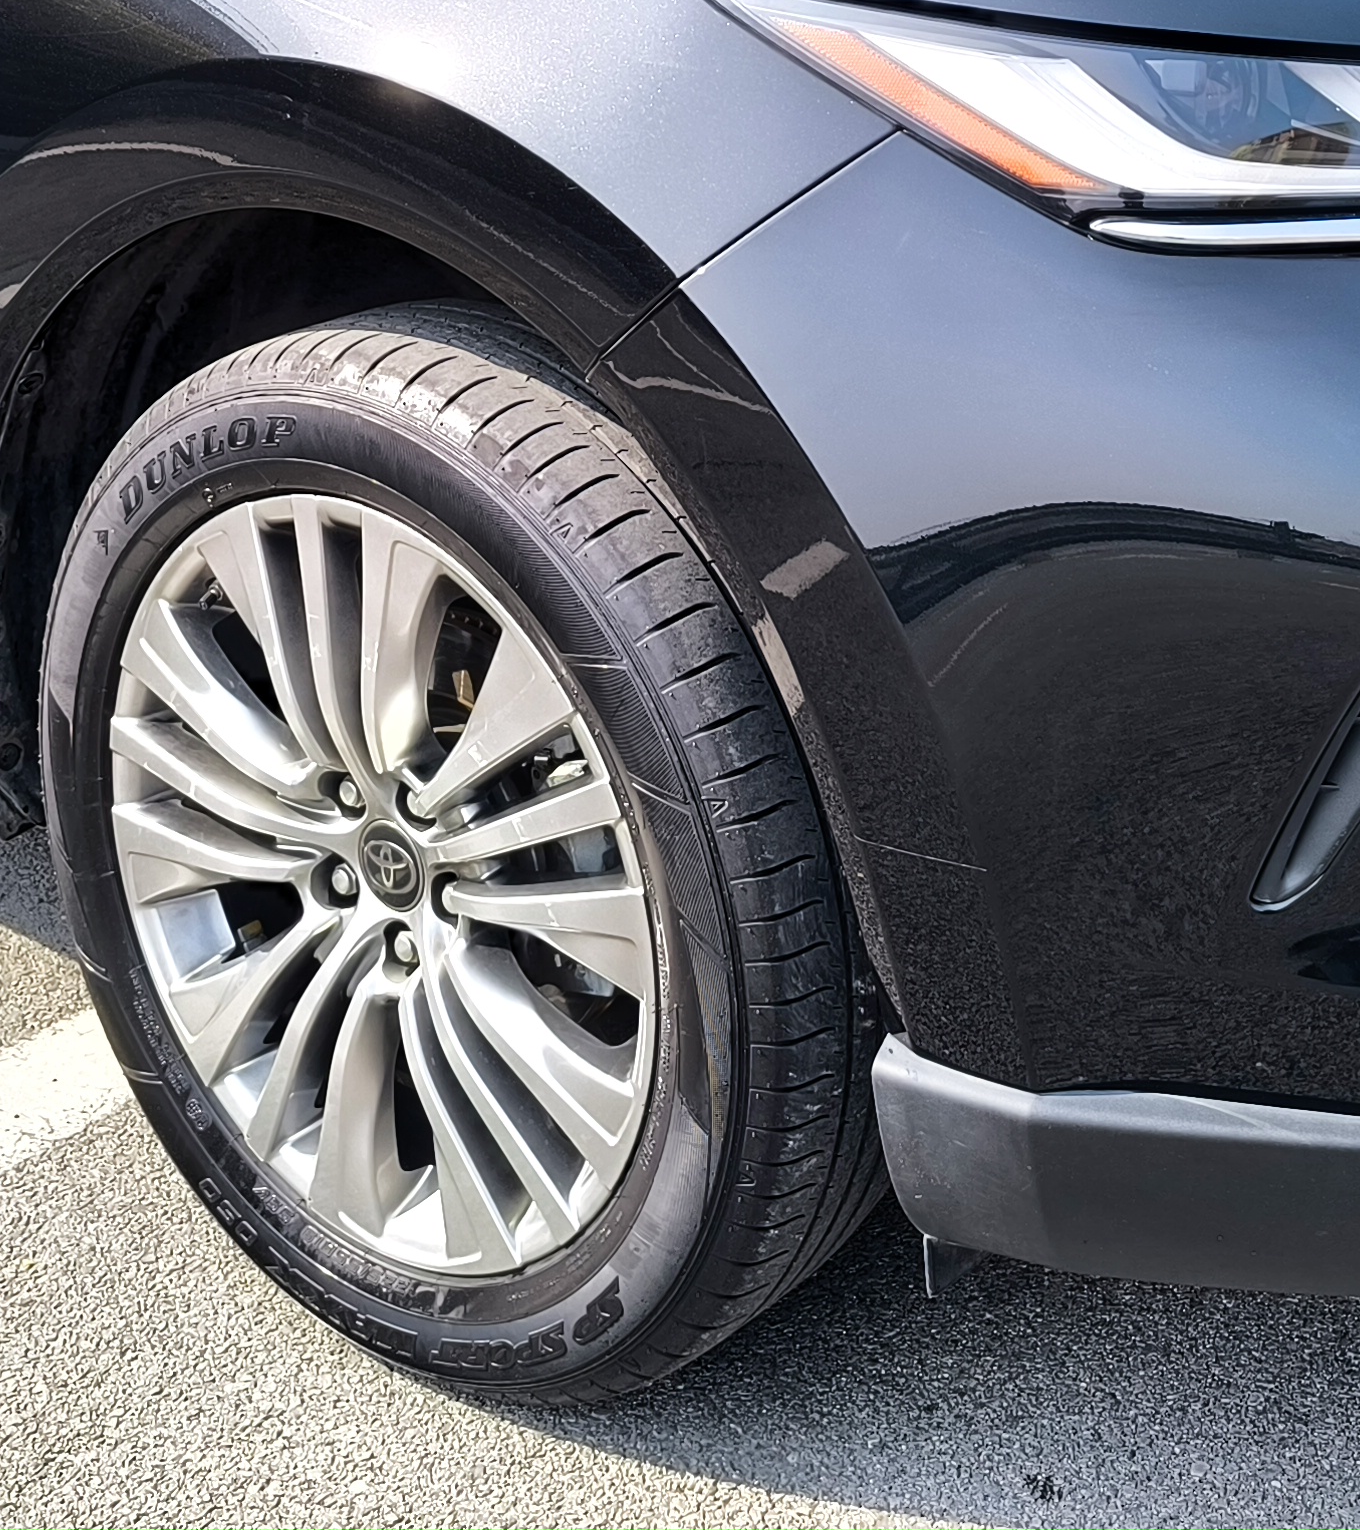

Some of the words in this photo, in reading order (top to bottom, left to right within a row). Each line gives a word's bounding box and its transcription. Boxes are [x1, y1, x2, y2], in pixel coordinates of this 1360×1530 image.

[119, 414, 298, 525] DUNLOP
[429, 1319, 567, 1370] SPORT
[572, 1275, 625, 1345] SP
